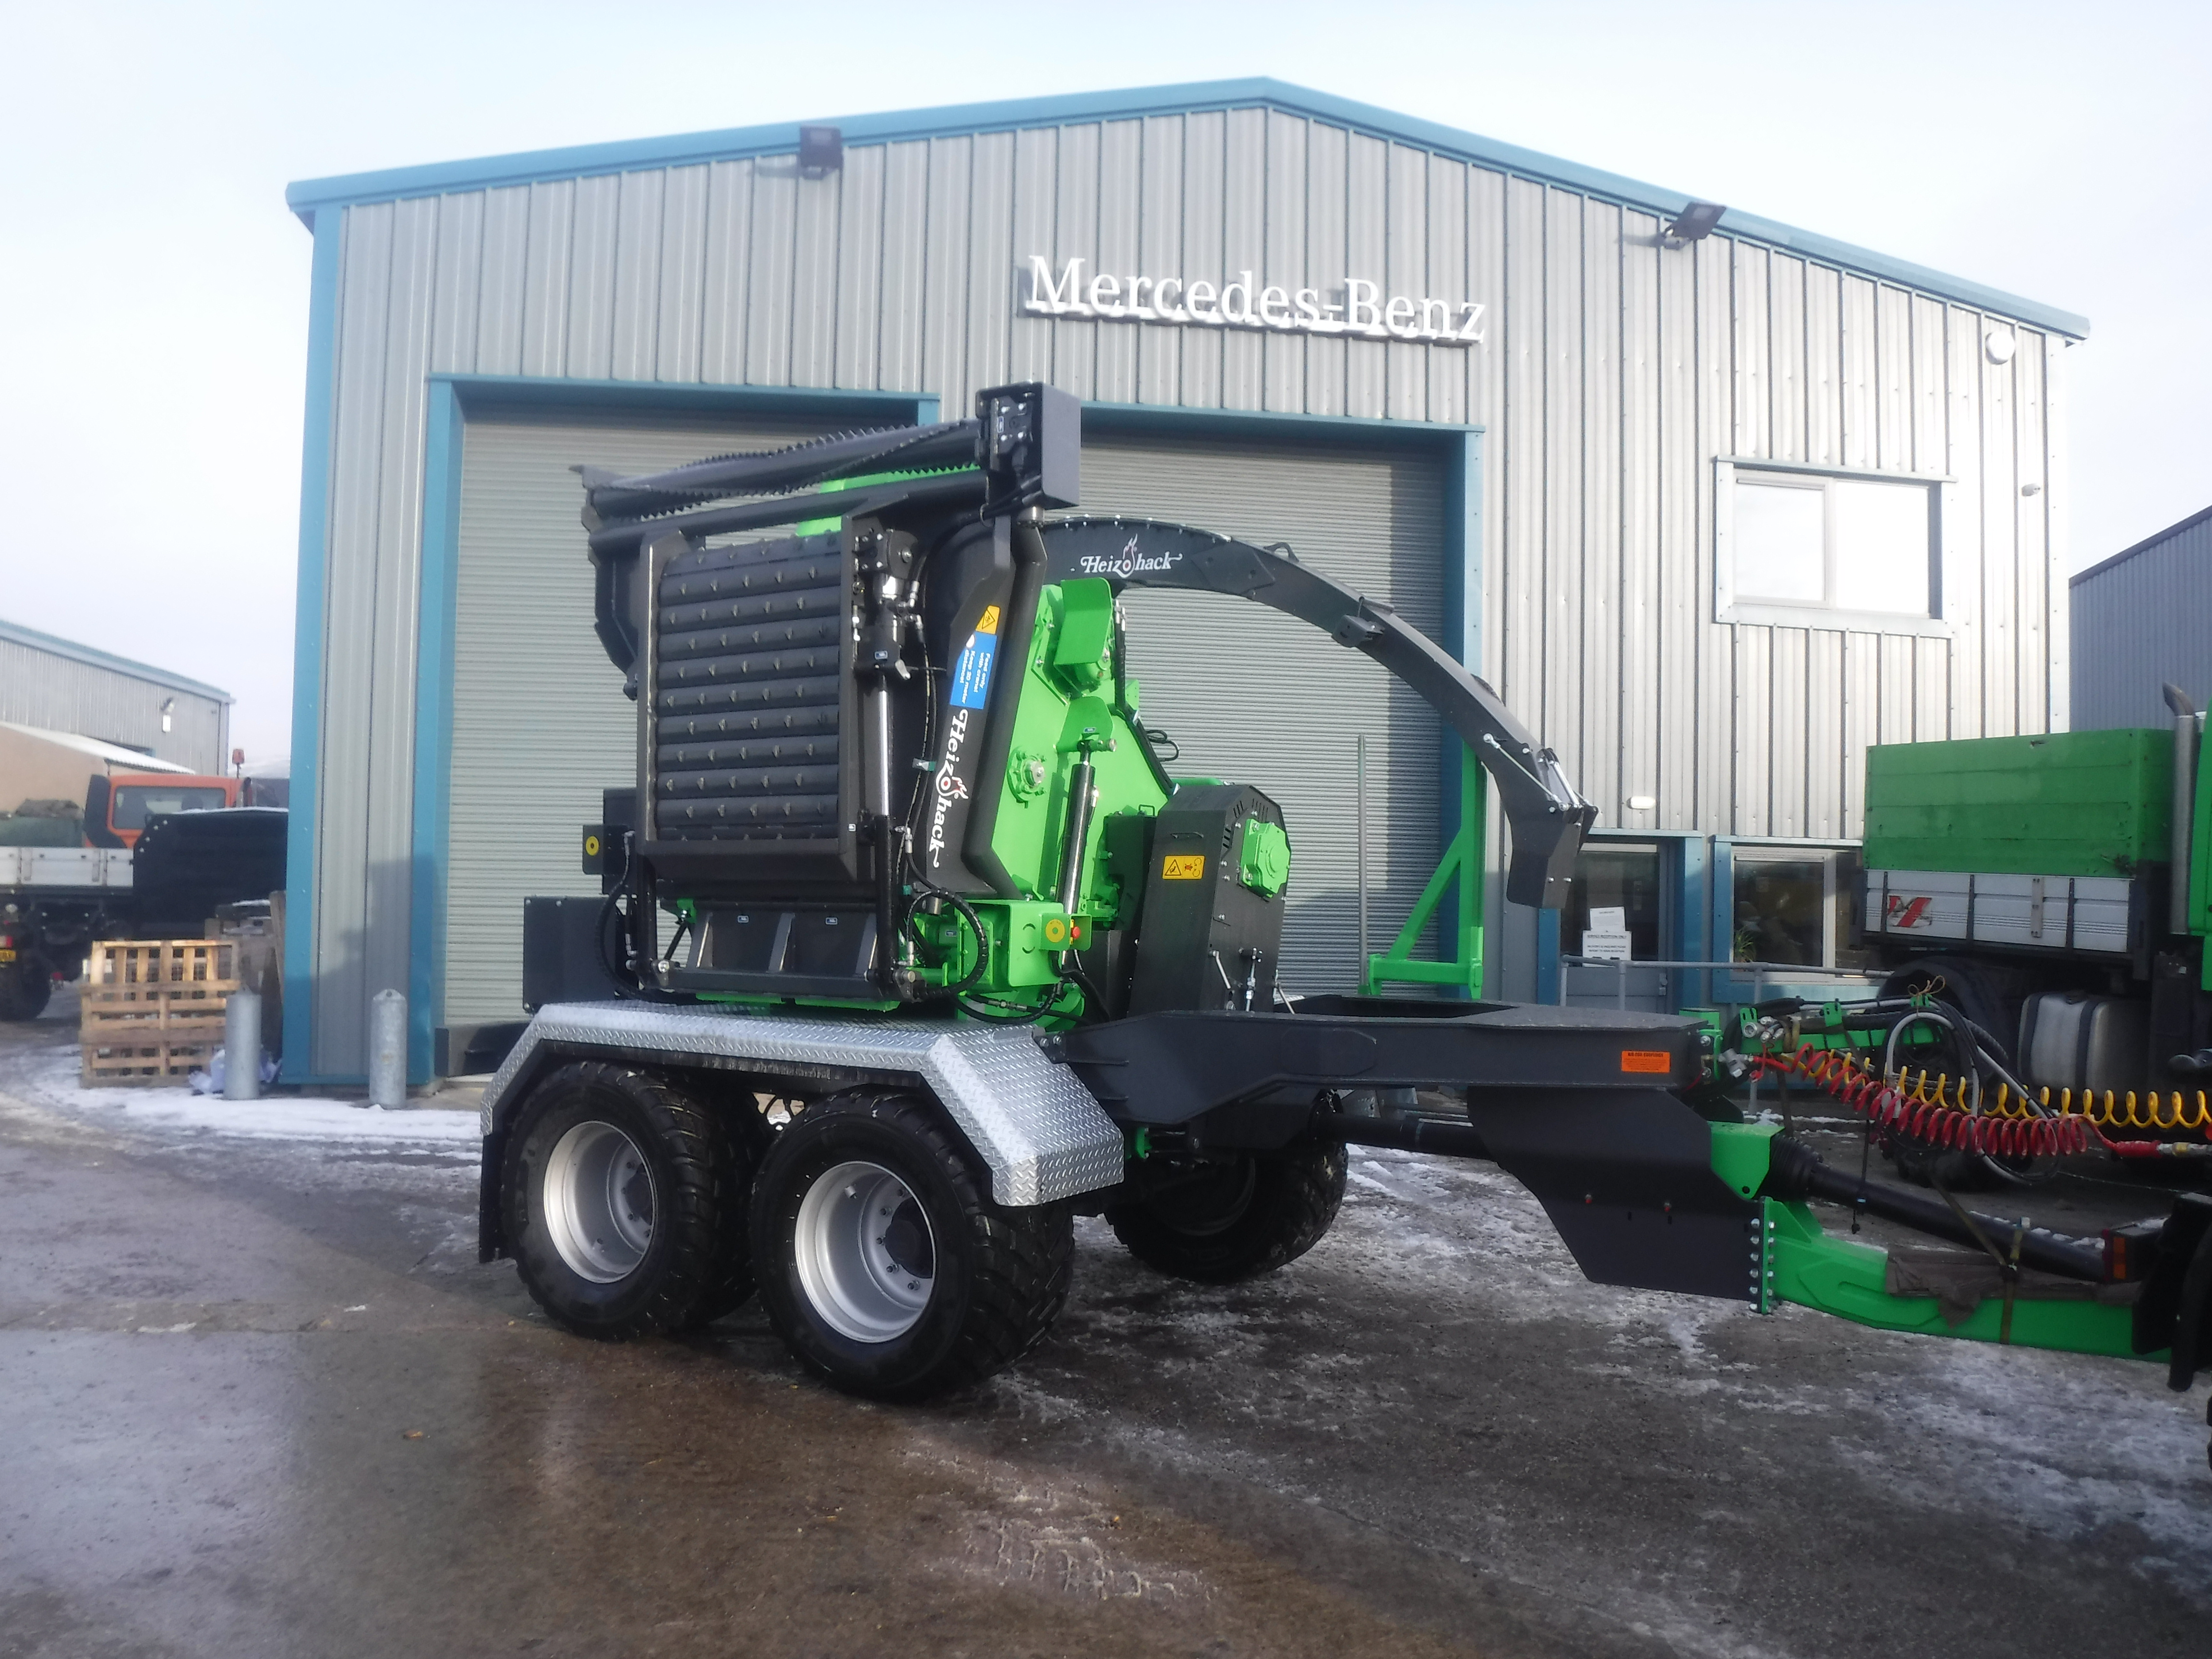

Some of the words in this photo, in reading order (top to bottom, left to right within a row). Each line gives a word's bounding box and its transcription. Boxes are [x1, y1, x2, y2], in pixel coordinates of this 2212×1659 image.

[1026, 255, 1487, 343] Mercedes-Benz
[960, 649, 969, 683] distance!
[967, 650, 975, 670] Keep
[966, 671, 972, 681] 20
